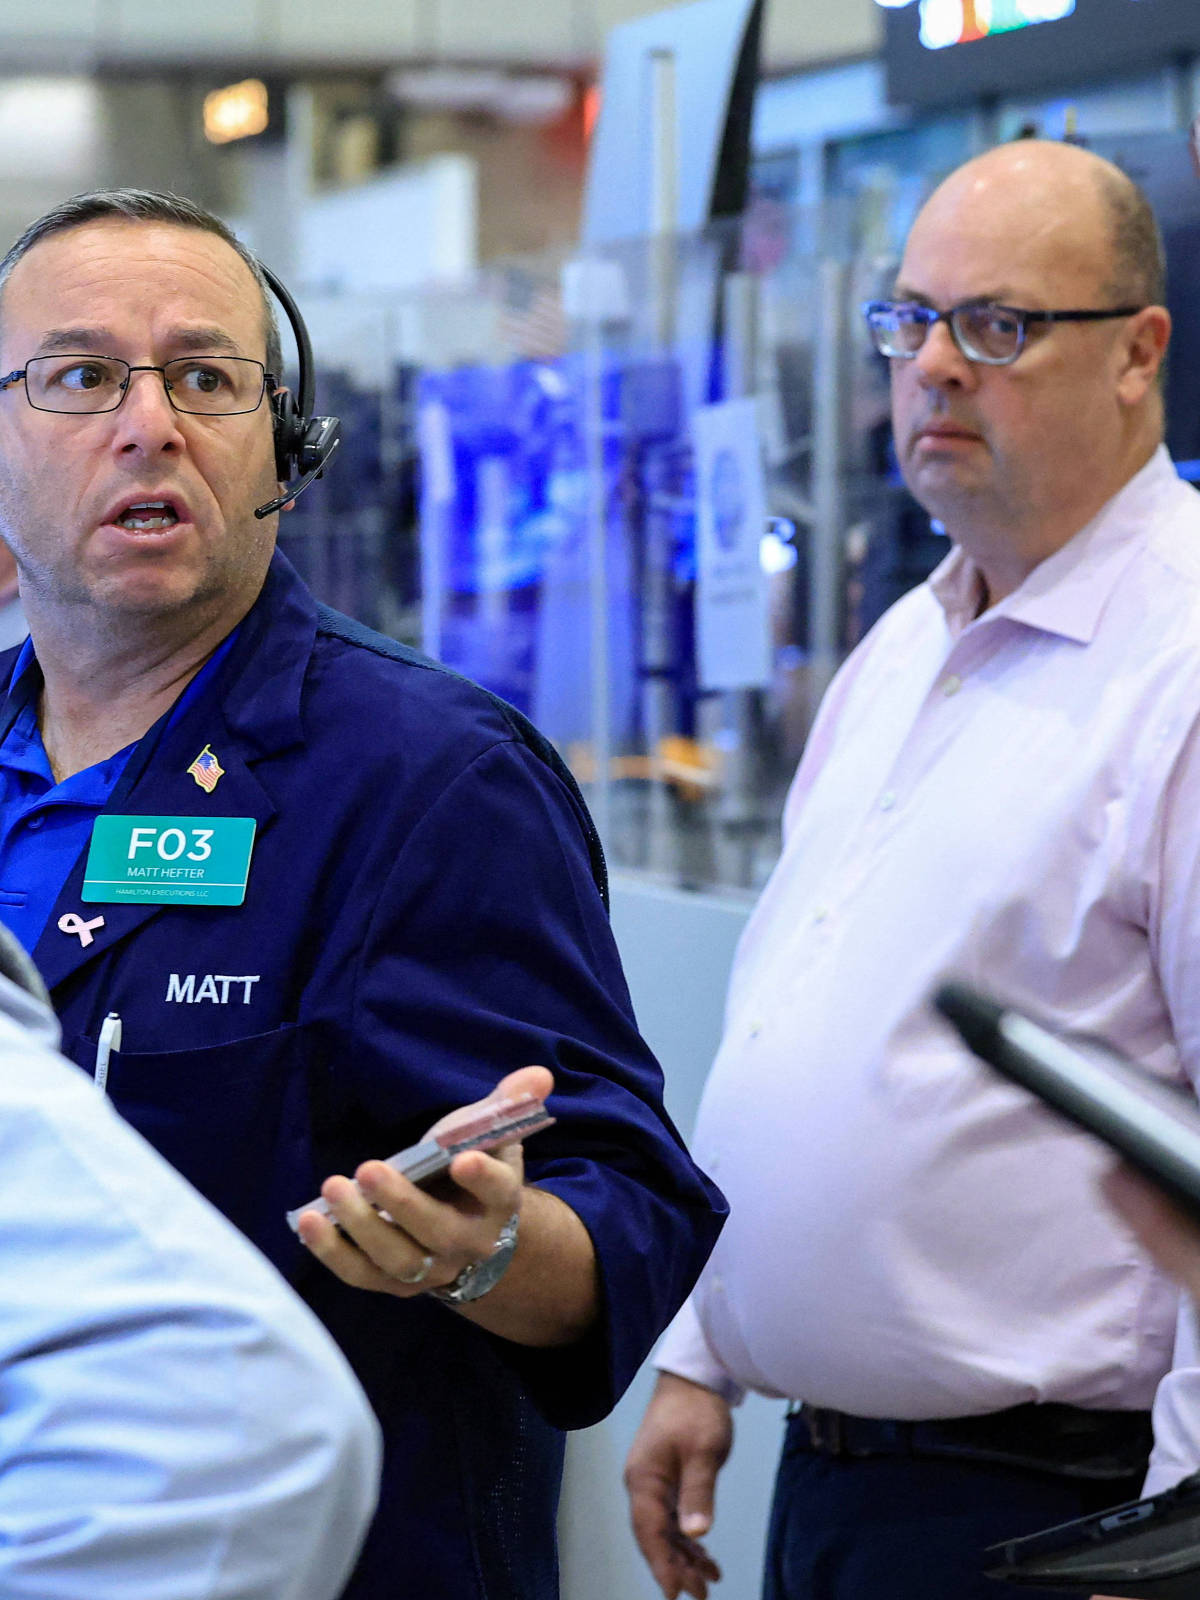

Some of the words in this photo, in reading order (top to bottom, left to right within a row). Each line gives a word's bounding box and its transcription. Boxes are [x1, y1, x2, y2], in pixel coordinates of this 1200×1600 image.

[127, 867, 160, 877] MATT
[160, 868, 205, 878] HEFTER
[115, 888, 151, 896] HAMILTON
[151, 889, 196, 897] EXECUTIONS
[165, 973, 261, 1004] MATT
